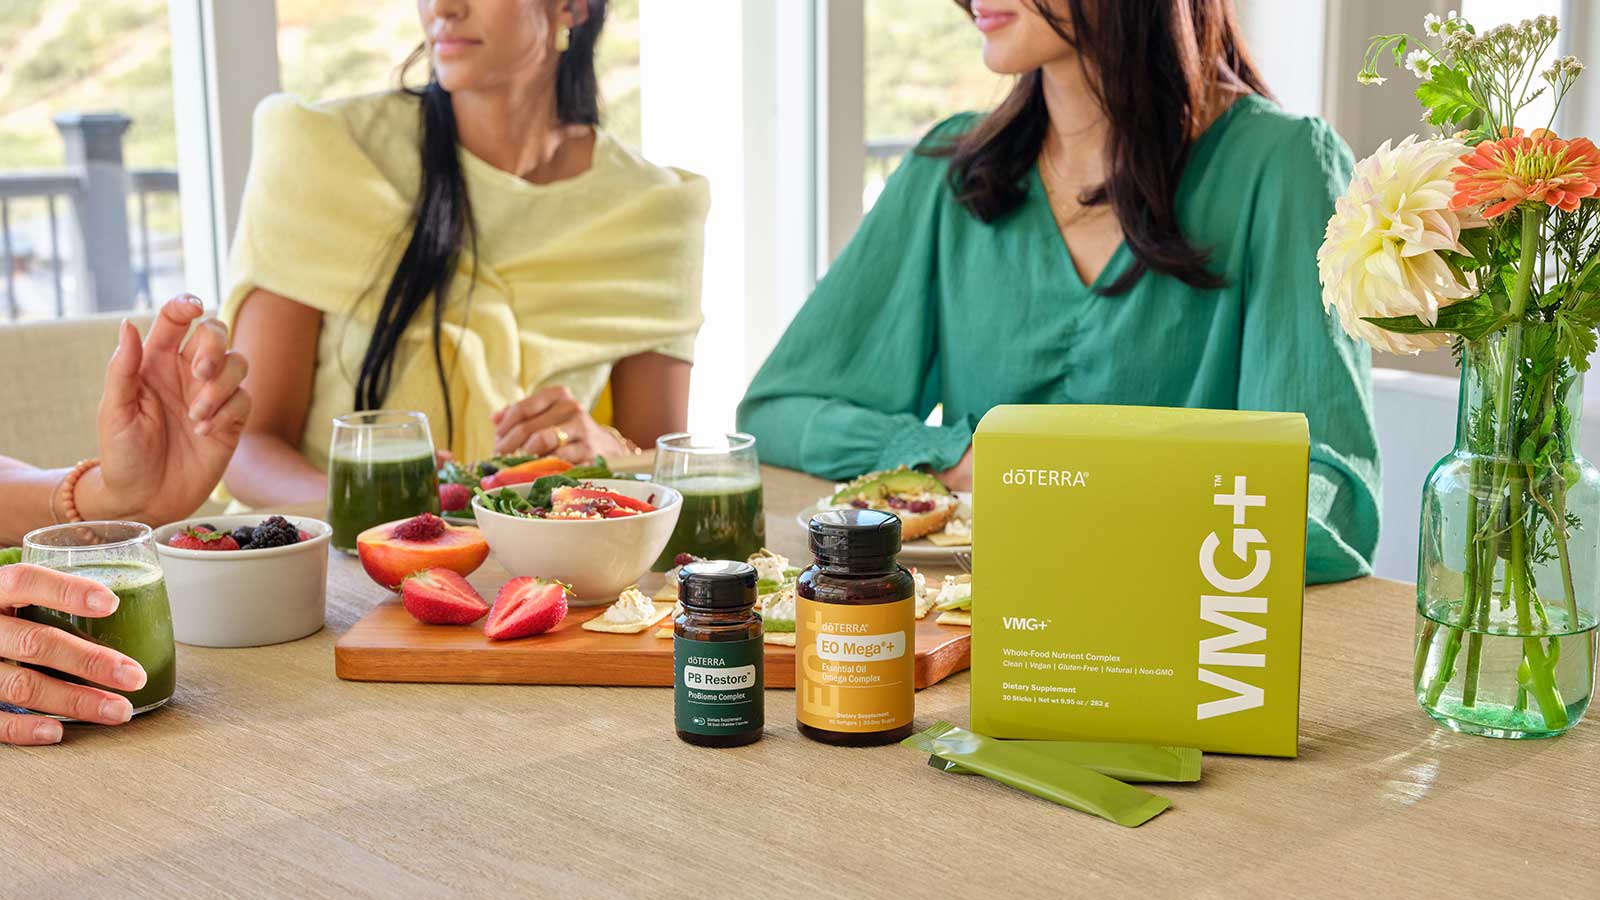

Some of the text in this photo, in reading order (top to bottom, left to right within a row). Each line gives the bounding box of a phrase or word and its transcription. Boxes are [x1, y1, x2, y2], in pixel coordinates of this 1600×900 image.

[821, 640, 839, 654] EO
[1002, 648, 1120, 663] Whole-Food Nutrient Complex
[821, 662, 867, 673] Essential Oil
[1002, 660, 1174, 677] Clean Vegan Gluten-Free Natural Non-GMO
[688, 672, 702, 683] PB
[848, 674, 880, 685] Complex
[1002, 682, 1076, 694] Dietary Supplement
[688, 690, 746, 701] ProBiome Complex
